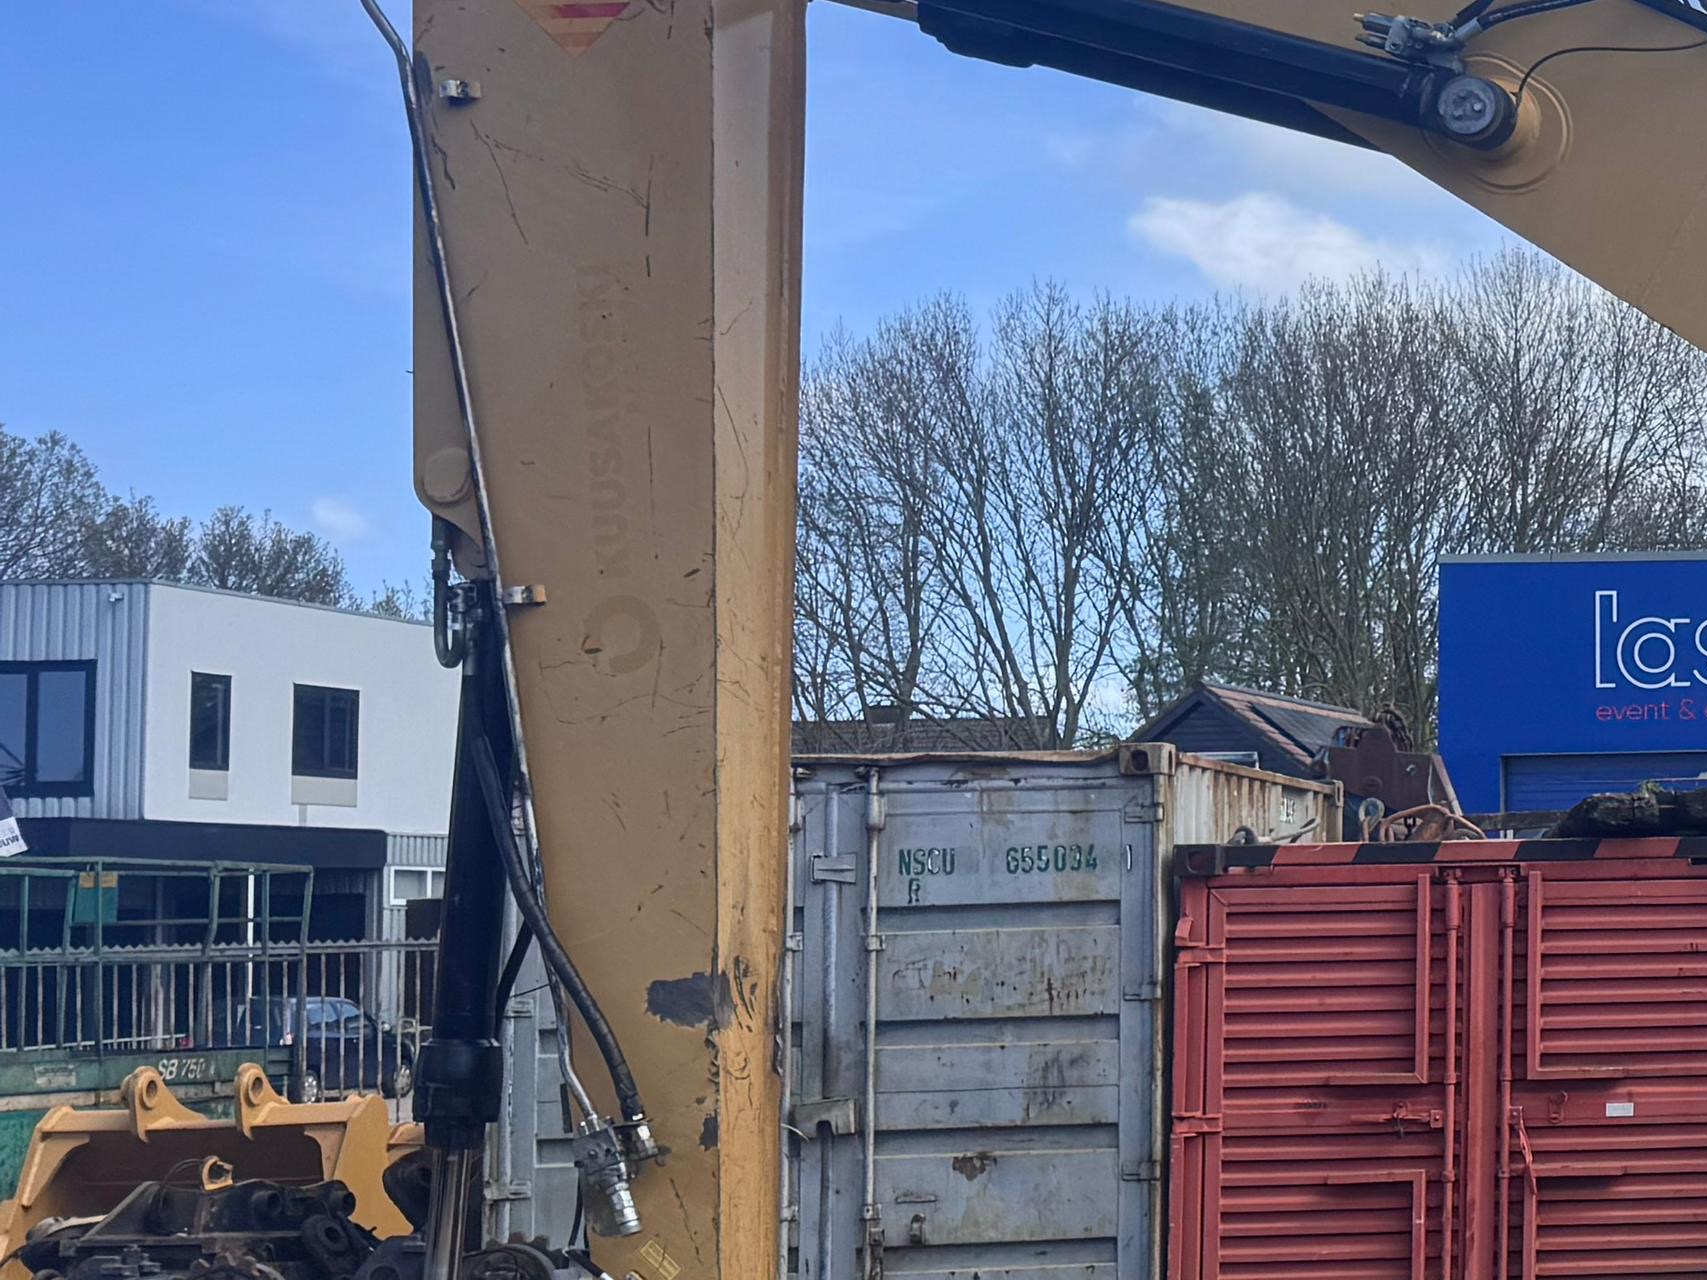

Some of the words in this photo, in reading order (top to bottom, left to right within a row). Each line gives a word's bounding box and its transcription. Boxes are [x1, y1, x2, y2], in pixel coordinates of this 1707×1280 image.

[1595, 699, 1671, 721] event
[1678, 698, 1697, 721] &
[898, 848, 956, 877] NSCU
